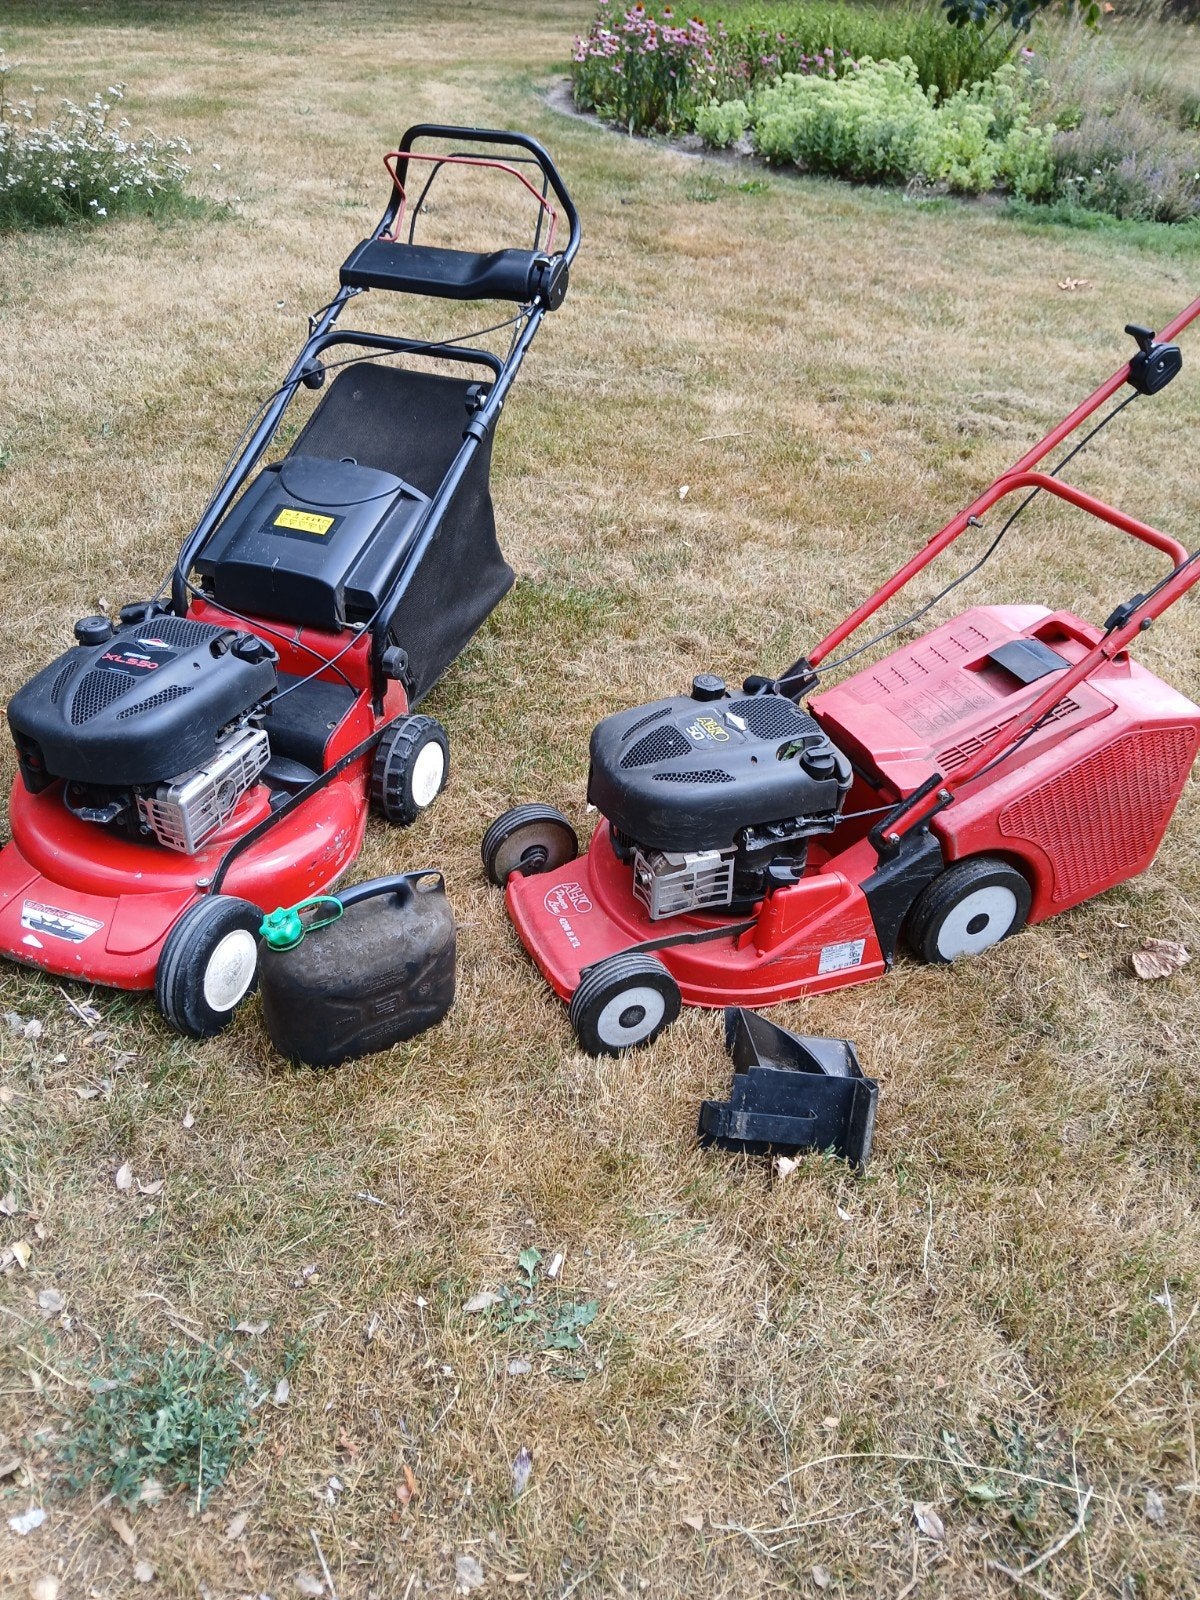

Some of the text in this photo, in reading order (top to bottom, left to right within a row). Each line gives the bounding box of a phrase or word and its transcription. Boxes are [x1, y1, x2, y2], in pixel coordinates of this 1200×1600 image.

[686, 725, 705, 741] 50
[547, 900, 561, 914] Line
[553, 889, 569, 910] Power
